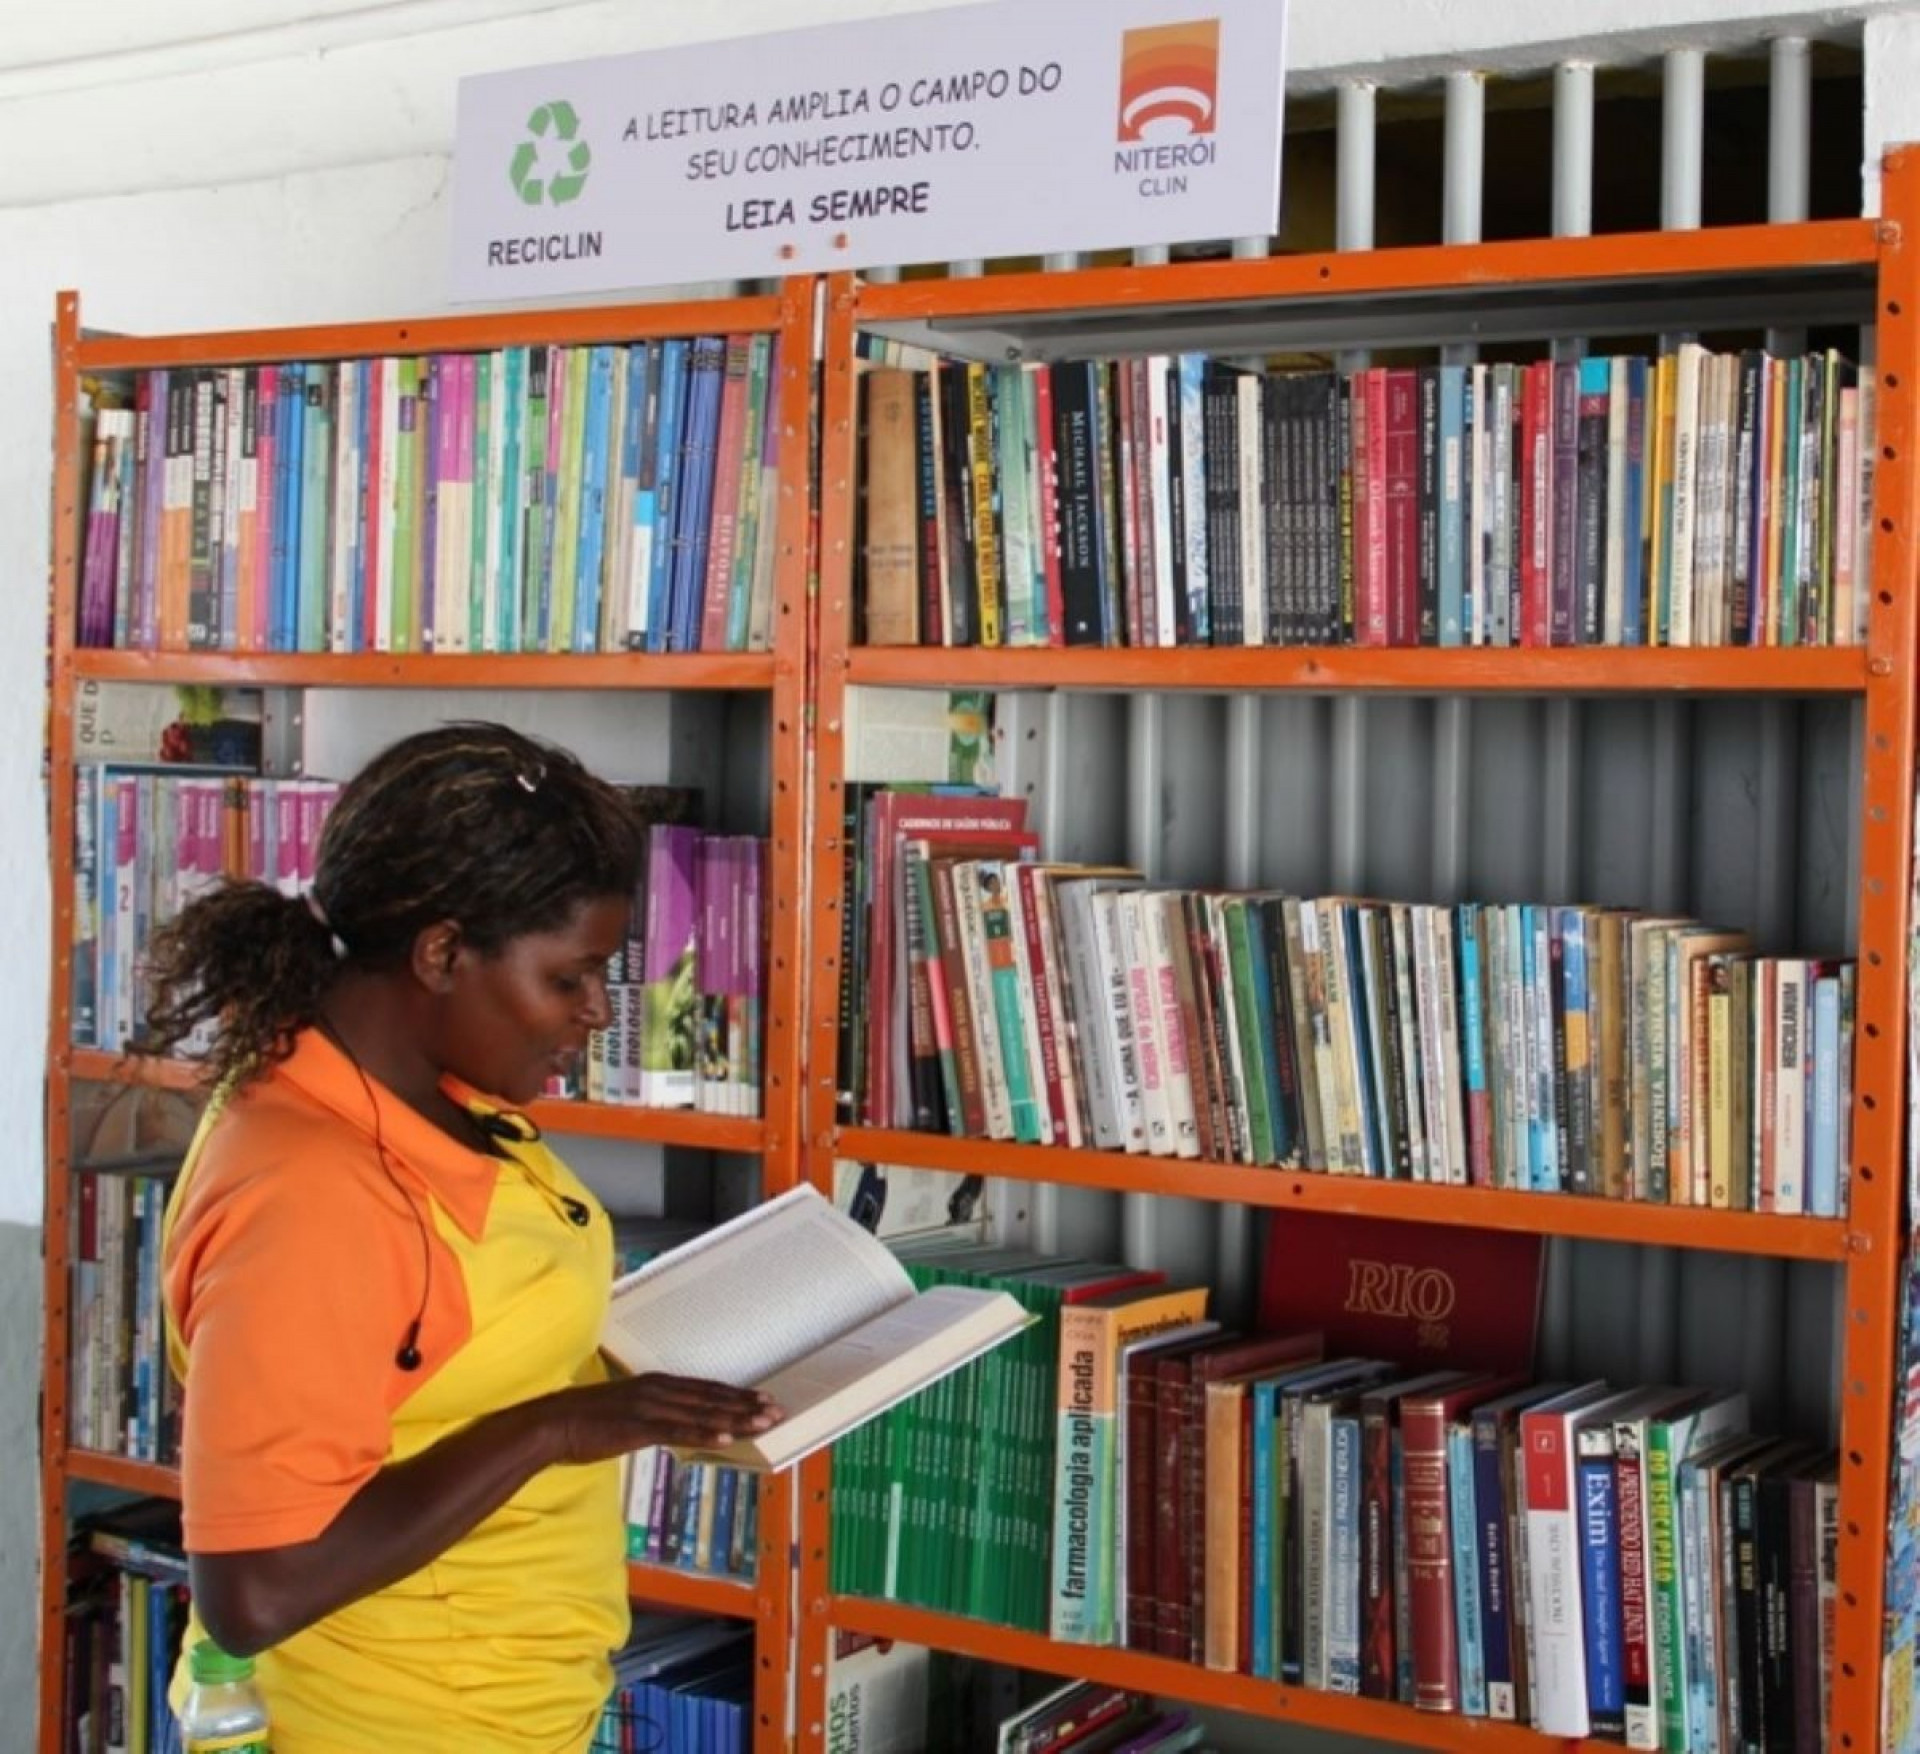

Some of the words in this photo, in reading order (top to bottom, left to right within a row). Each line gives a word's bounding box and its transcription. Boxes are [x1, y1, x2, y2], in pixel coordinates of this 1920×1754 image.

[622, 117, 638, 141] A
[646, 101, 758, 141] LEITURA
[767, 91, 870, 124] AMPLIA
[879, 85, 902, 112] O
[909, 69, 1009, 108] CAMPO
[1018, 62, 1062, 96] DO
[686, 149, 737, 181] SEU
[741, 122, 980, 174] CONHECIMENTO.
[1114, 137, 1215, 173] NITERÓI
[725, 198, 796, 233] LEIA
[808, 181, 931, 224] SEMPRE
[1139, 176, 1187, 197] CLIN
[487, 231, 603, 267] RECICLIN
[1072, 411, 1087, 488] MICHAEL
[1075, 491, 1090, 567] JACKSON
[80, 702, 96, 743] QUE
[1345, 1258, 1456, 1321] RIO
[1068, 1349, 1094, 1448] aplicada
[1062, 1453, 1095, 1599] farmacologia
[1586, 1473, 1611, 1545] Exim
